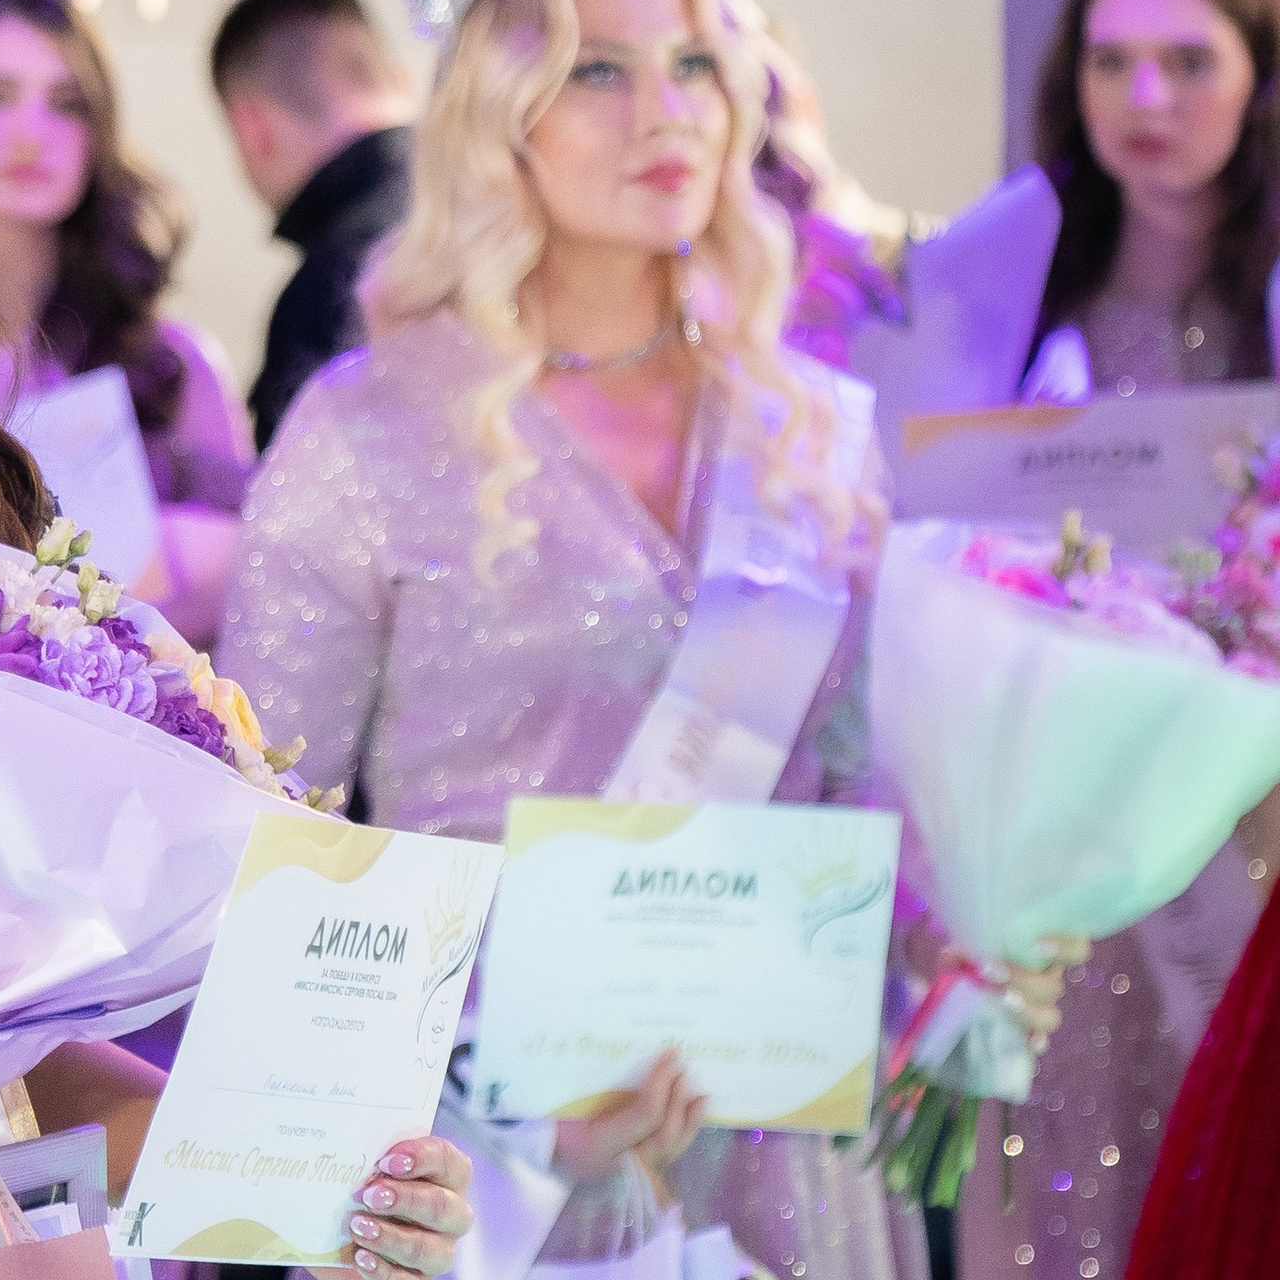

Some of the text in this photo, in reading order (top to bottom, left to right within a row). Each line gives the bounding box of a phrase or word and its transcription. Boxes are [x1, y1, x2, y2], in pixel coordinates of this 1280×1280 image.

[611, 868, 758, 900] ДИПЛОМ
[305, 916, 409, 964] ДИПЛОМ
[240, 1146, 310, 1187] Сергиев
